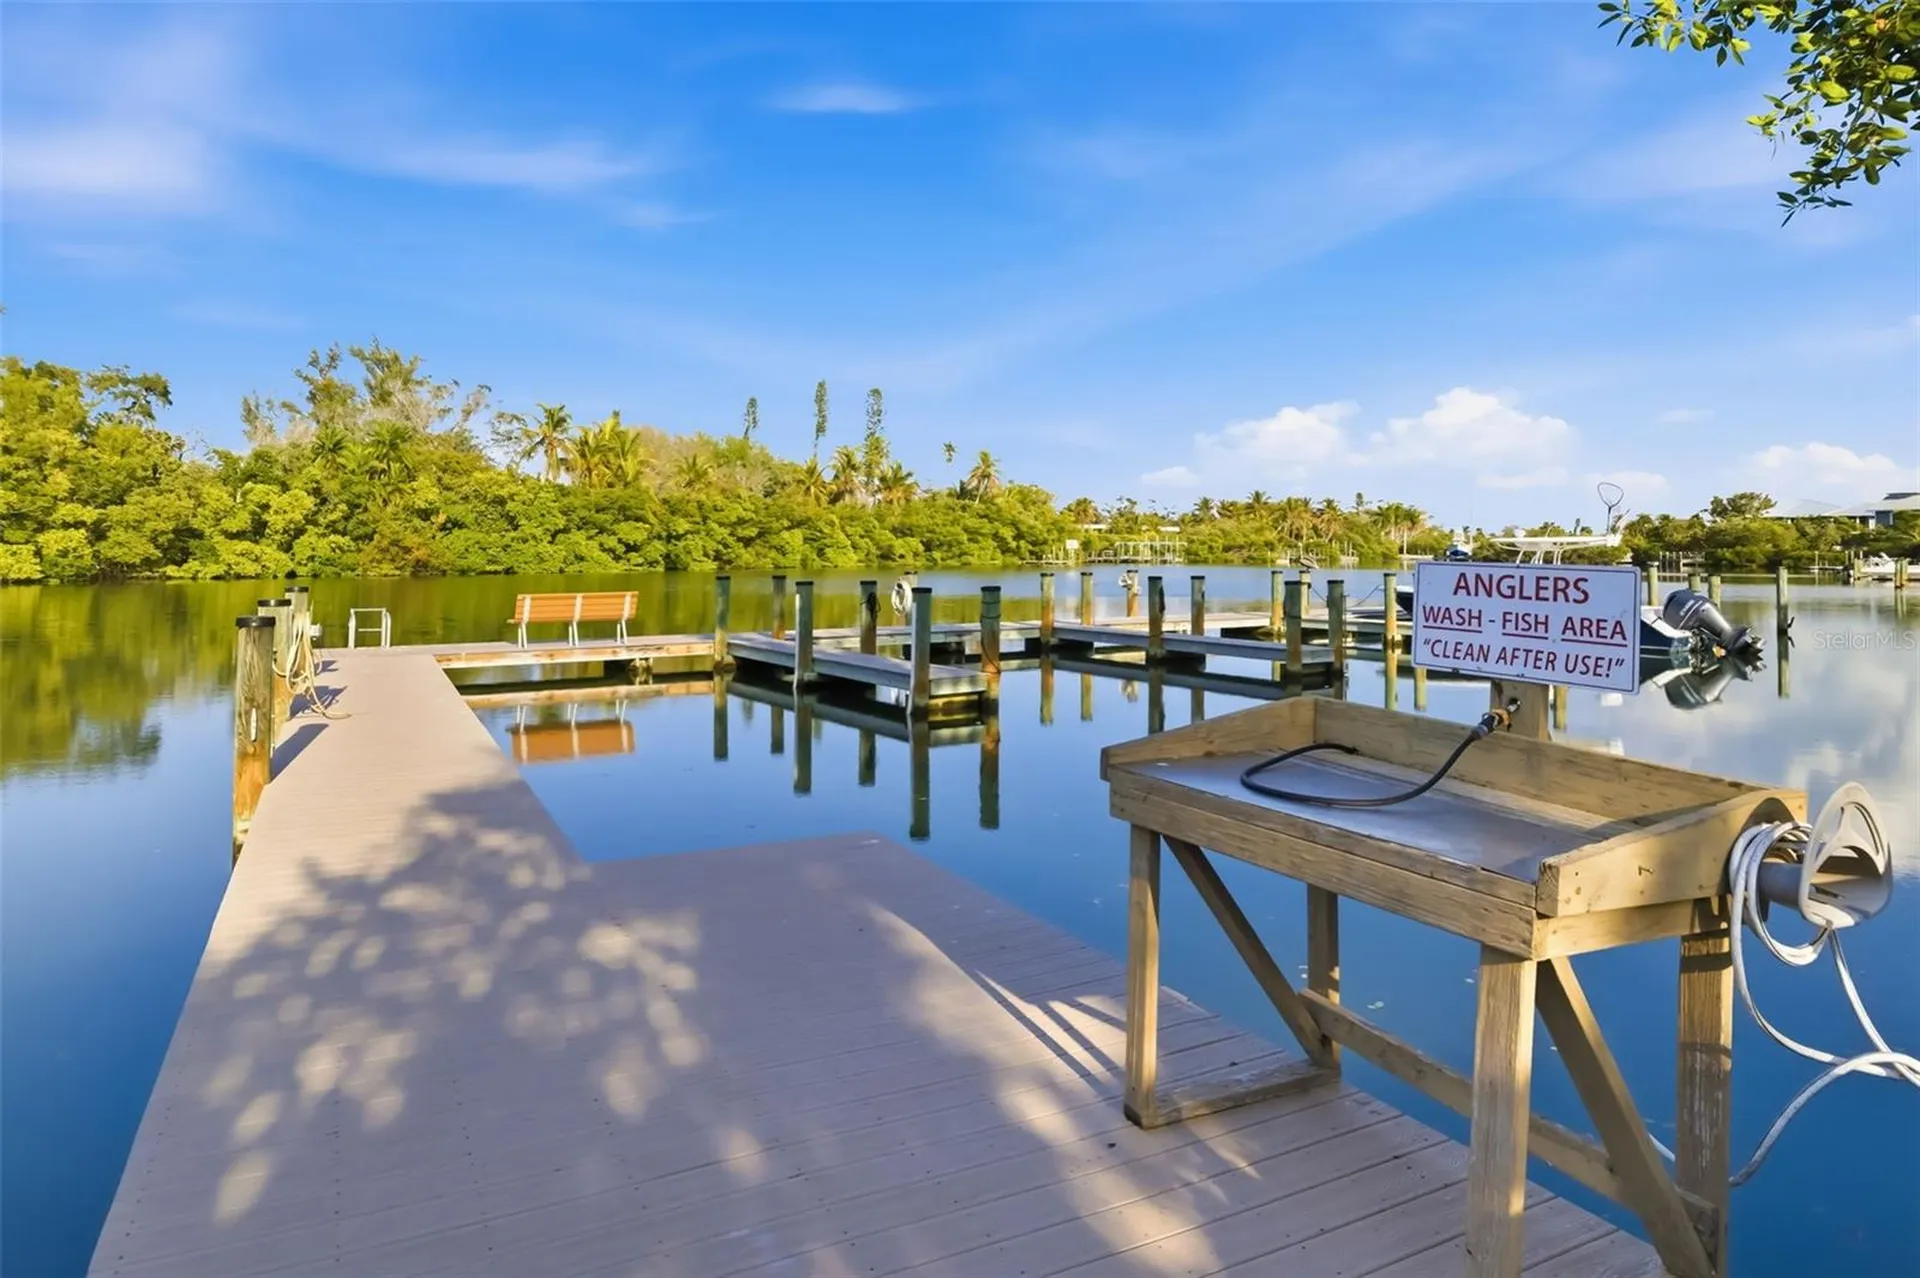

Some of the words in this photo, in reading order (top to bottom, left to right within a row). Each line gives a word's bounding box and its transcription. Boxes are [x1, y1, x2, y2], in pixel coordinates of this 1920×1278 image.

[1453, 572, 1589, 604] ANGLERS
[1422, 605, 1482, 628] WASH
[1502, 611, 1549, 634] FISH
[1561, 616, 1627, 641] AREA
[1495, 646, 1557, 672] AFTER
